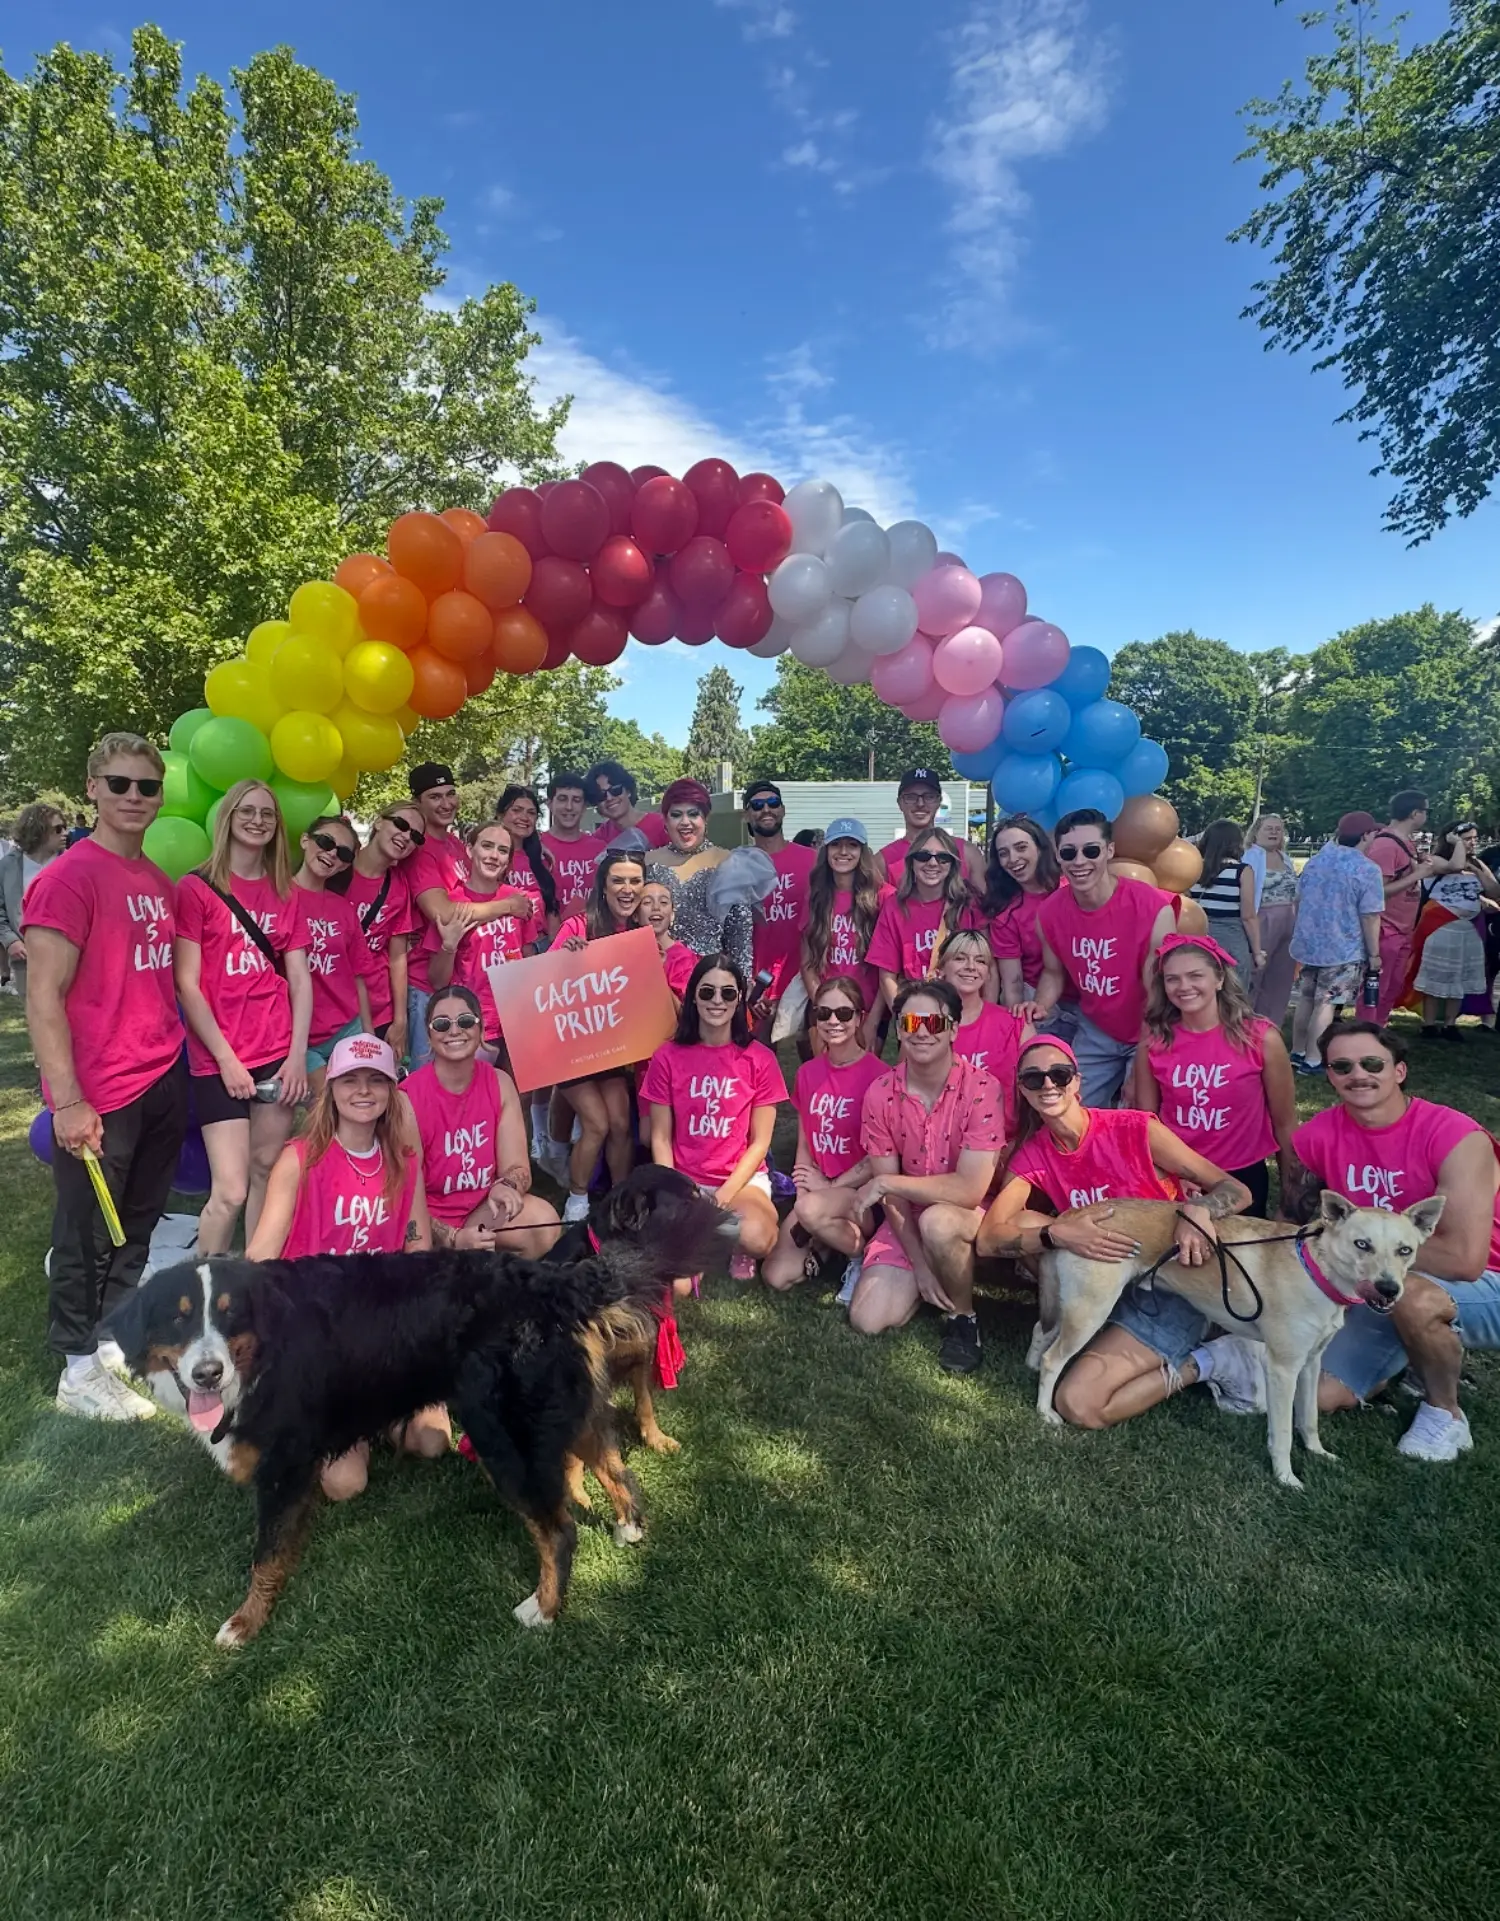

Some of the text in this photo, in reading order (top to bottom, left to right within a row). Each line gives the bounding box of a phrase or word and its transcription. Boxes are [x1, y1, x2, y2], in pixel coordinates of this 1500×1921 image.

[508, 870, 535, 886] OVE
[560, 859, 594, 877] LOVE
[574, 875, 585, 889] IS
[777, 873, 795, 890] VE
[773, 891, 785, 904] IS
[763, 902, 798, 922] LOVE
[146, 922, 158, 942] S
[307, 916, 341, 937] OVE
[313, 936, 327, 953] IS
[493, 934, 507, 950] IS
[837, 932, 850, 947] IS
[915, 929, 938, 952] LO
[1072, 936, 1118, 960] LOVE
[307, 952, 340, 976] OVE
[1087, 958, 1101, 975] IS
[533, 965, 629, 1014] CACTUS
[1078, 971, 1121, 997] LOVE
[554, 998, 624, 1042] PRIDE
[690, 1075, 740, 1099] LOVE
[1172, 1063, 1232, 1089] LOVE
[706, 1098, 720, 1115] IS
[809, 1092, 855, 1119] LOVE
[1192, 1087, 1210, 1107] IS
[688, 1113, 737, 1139] LOVE
[821, 1115, 834, 1133] IS
[1176, 1104, 1232, 1131] LOVE
[444, 1120, 489, 1157] LOVE
[812, 1131, 851, 1155] LOVE
[461, 1151, 476, 1171] IS
[443, 1163, 494, 1195] LOVE
[1346, 1163, 1405, 1198] LOVE
[334, 1195, 390, 1226] LOVE
[1373, 1192, 1394, 1212] IS
[351, 1225, 370, 1249] IS
